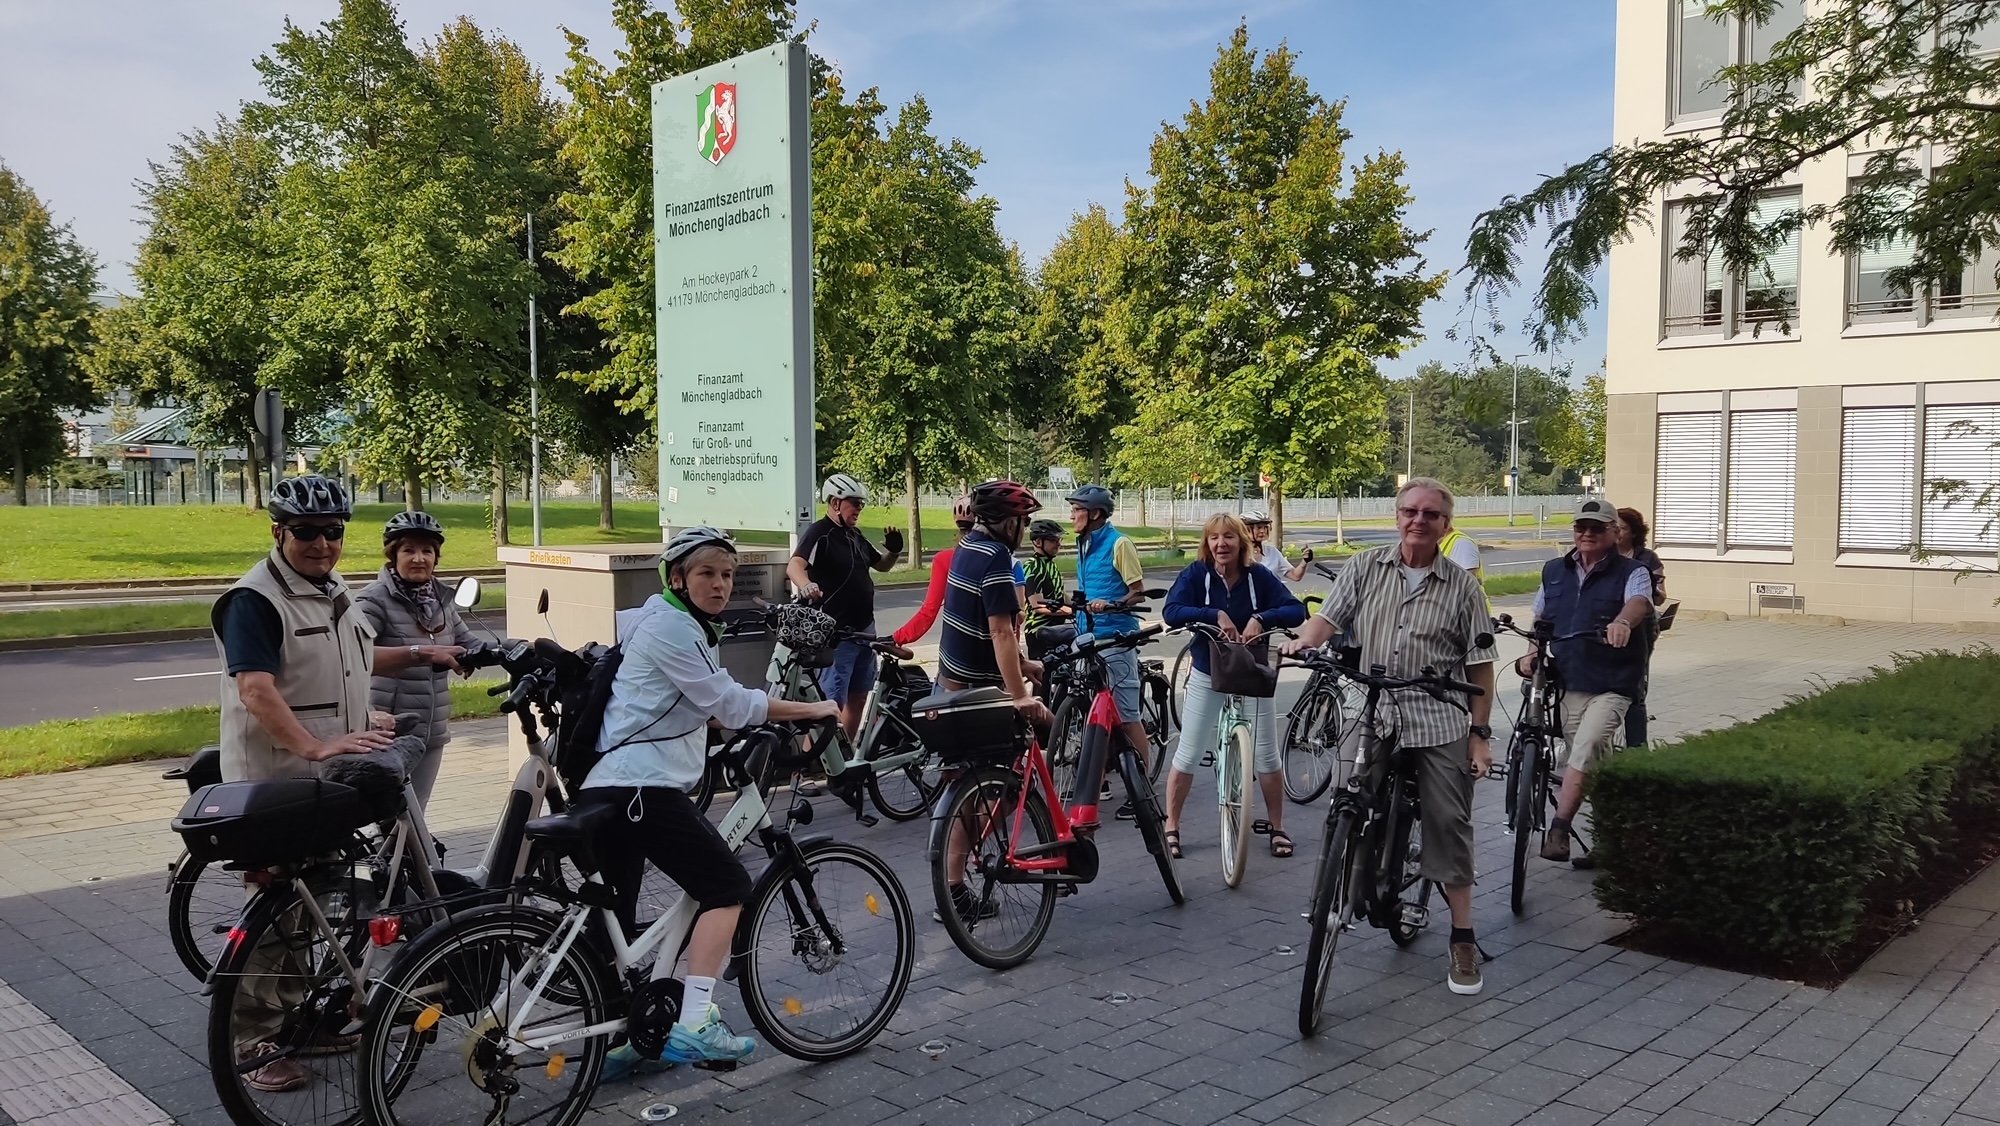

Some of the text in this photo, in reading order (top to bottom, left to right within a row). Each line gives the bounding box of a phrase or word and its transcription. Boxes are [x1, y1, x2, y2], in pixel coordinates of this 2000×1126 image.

[665, 183, 774, 218] Finanzamtszentrum
[669, 204, 770, 238] Mönchengladbach
[682, 264, 758, 288] Am Hockeypark 2
[667, 280, 775, 307] 41179 Mönchengladbach
[697, 371, 744, 386] Finanzamt
[681, 387, 762, 403] Mönchengladbach
[698, 420, 744, 433] Finanzamt
[692, 436, 752, 449] für Groß- und
[669, 453, 778, 468] Konzenbetriebsprüfung
[682, 469, 764, 484] Mönchengladbach
[529, 550, 572, 566] Briefkasten
[726, 812, 748, 844] RTEX
[562, 1027, 591, 1040] VORTEX
